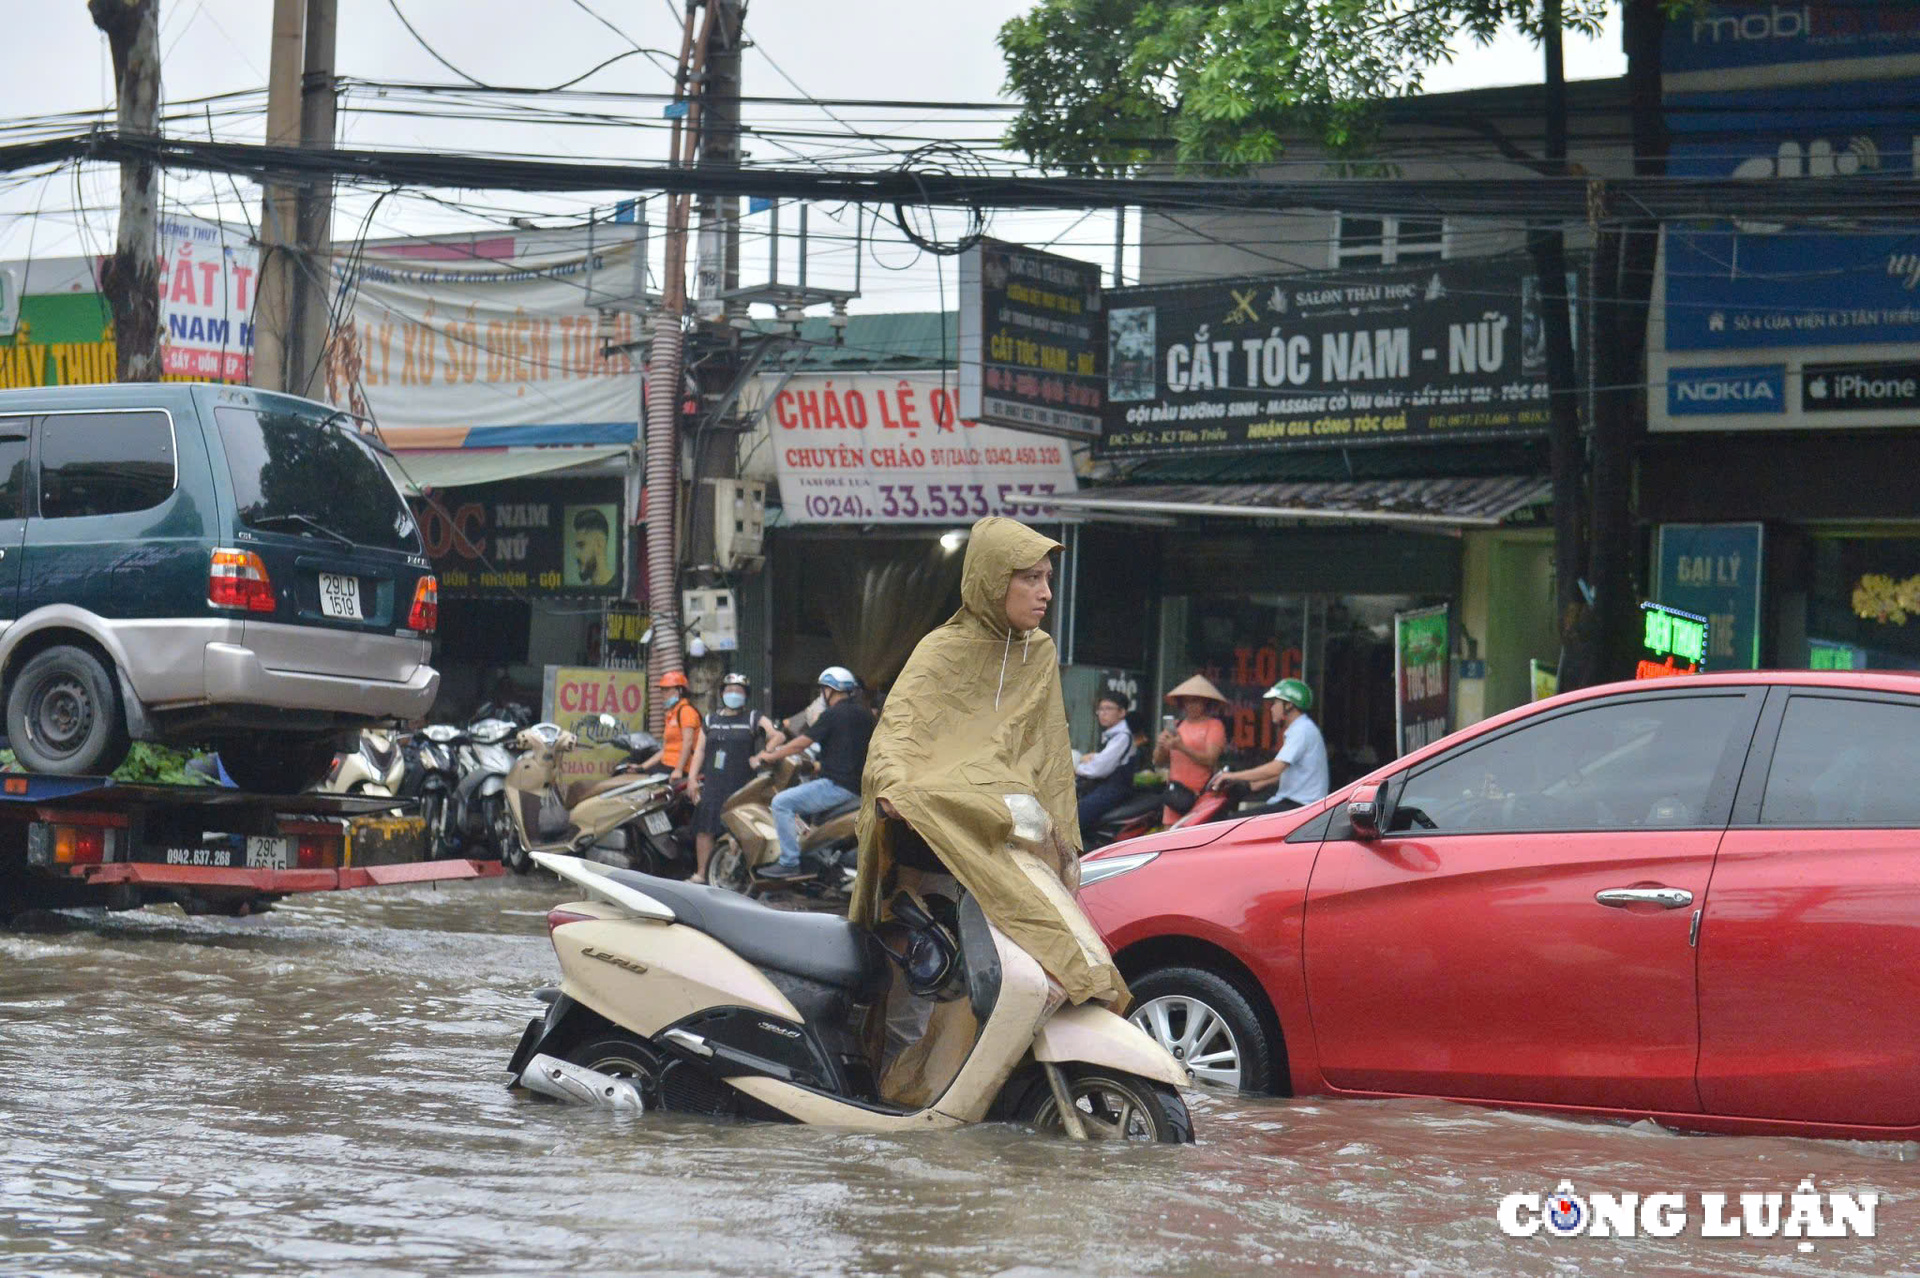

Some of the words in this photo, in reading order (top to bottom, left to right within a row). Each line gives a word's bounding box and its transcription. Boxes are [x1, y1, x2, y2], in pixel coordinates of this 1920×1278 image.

[1295, 288, 1342, 307] SALON
[169, 313, 230, 345] NAM
[1167, 323, 1233, 393] CẮT
[1242, 326, 1310, 387] TÓC
[1322, 327, 1410, 382] NAM
[1449, 311, 1508, 375] NỮ
[1677, 379, 1775, 402] NOKIA
[1833, 375, 1916, 399] iPhone
[774, 381, 869, 431] CHÁO
[877, 380, 922, 438] LỆ
[1126, 404, 1151, 426] GỘI
[1179, 401, 1227, 420] DƯỠNG
[1228, 401, 1259, 417] SINH
[1266, 398, 1327, 415] MASSAGE
[1287, 420, 1311, 435] GIA
[1312, 415, 1352, 435] CÔNG
[1354, 412, 1380, 433] TÓC
[785, 444, 865, 468] CHUYÊN
[870, 443, 926, 468] CHÁO
[495, 503, 549, 527] NAM
[805, 494, 873, 518] (024).
[323, 574, 355, 597] 29LD
[329, 596, 355, 617] 1519
[559, 674, 642, 714] CHÁO
[255, 838, 278, 859] 29C
[580, 945, 648, 975] LEAD
